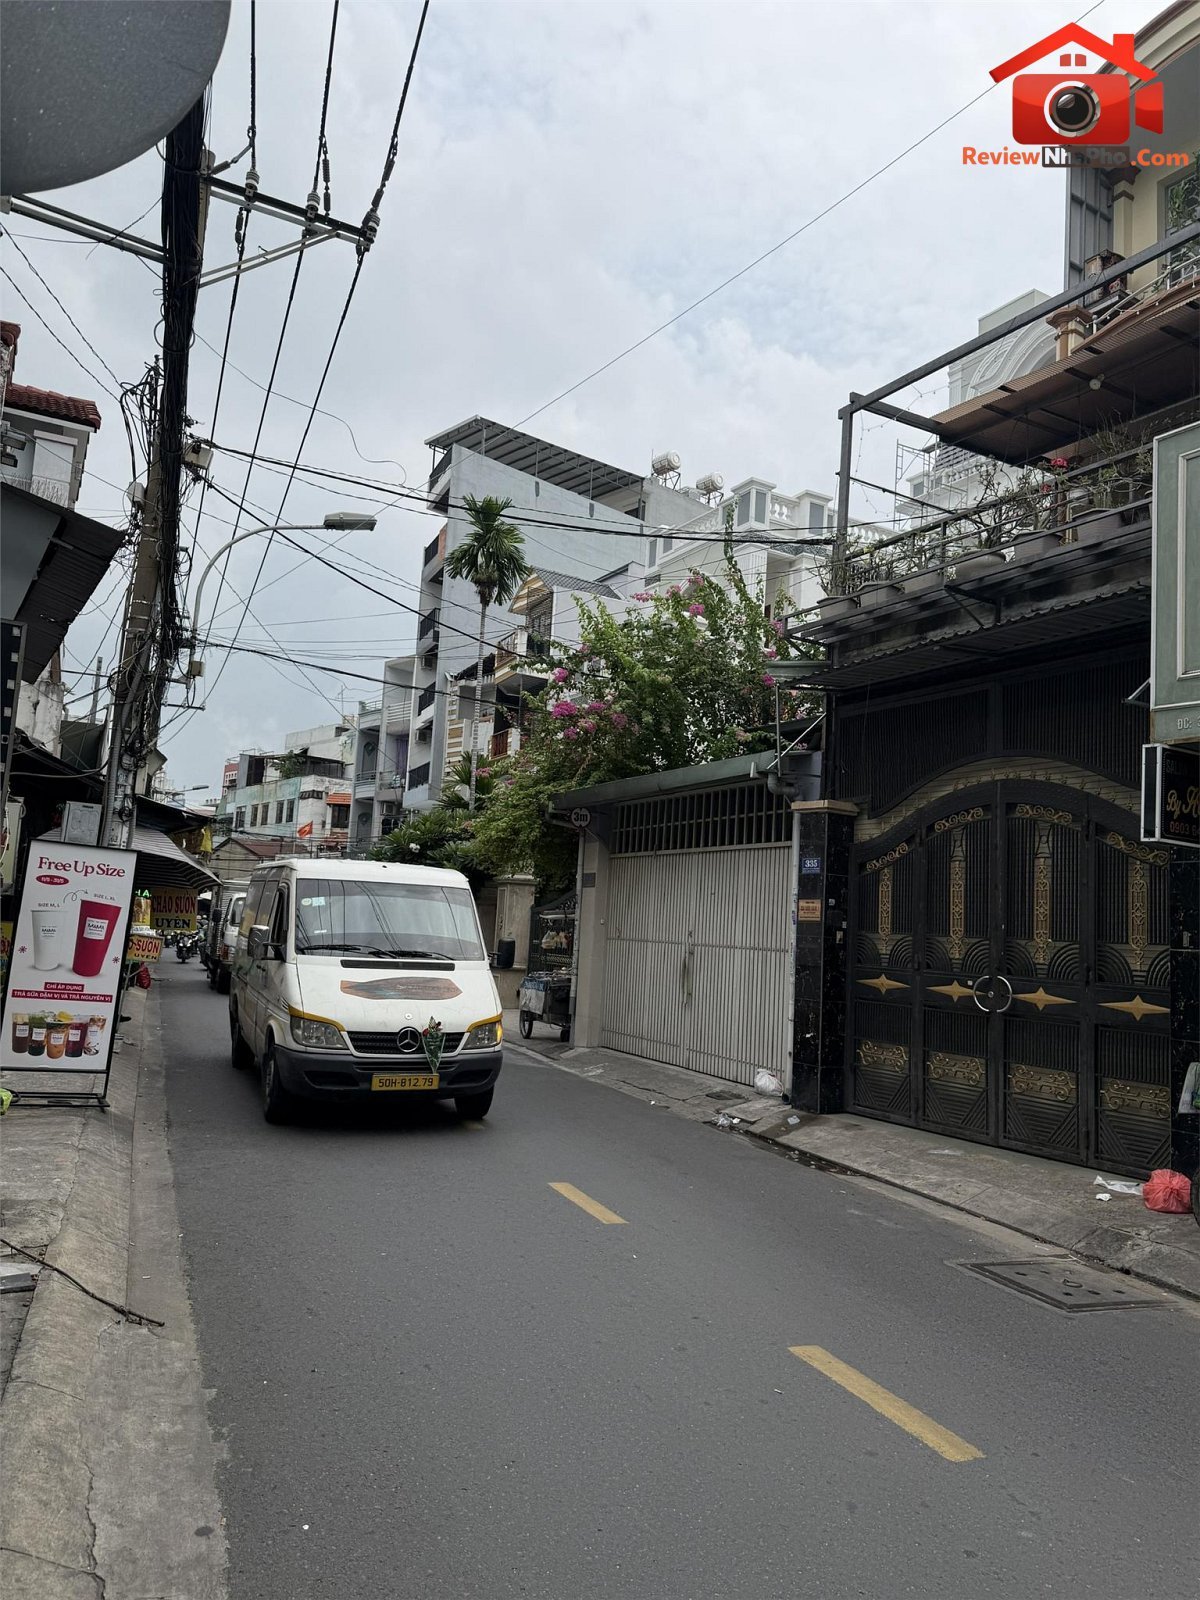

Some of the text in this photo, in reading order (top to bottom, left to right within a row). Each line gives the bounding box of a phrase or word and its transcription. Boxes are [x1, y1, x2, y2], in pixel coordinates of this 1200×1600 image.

[1166, 790, 1182, 820] By
[38, 857, 125, 877] Free Up Size
[155, 916, 191, 928] UYÊN
[379, 1077, 433, 1087] 50H-812.79
